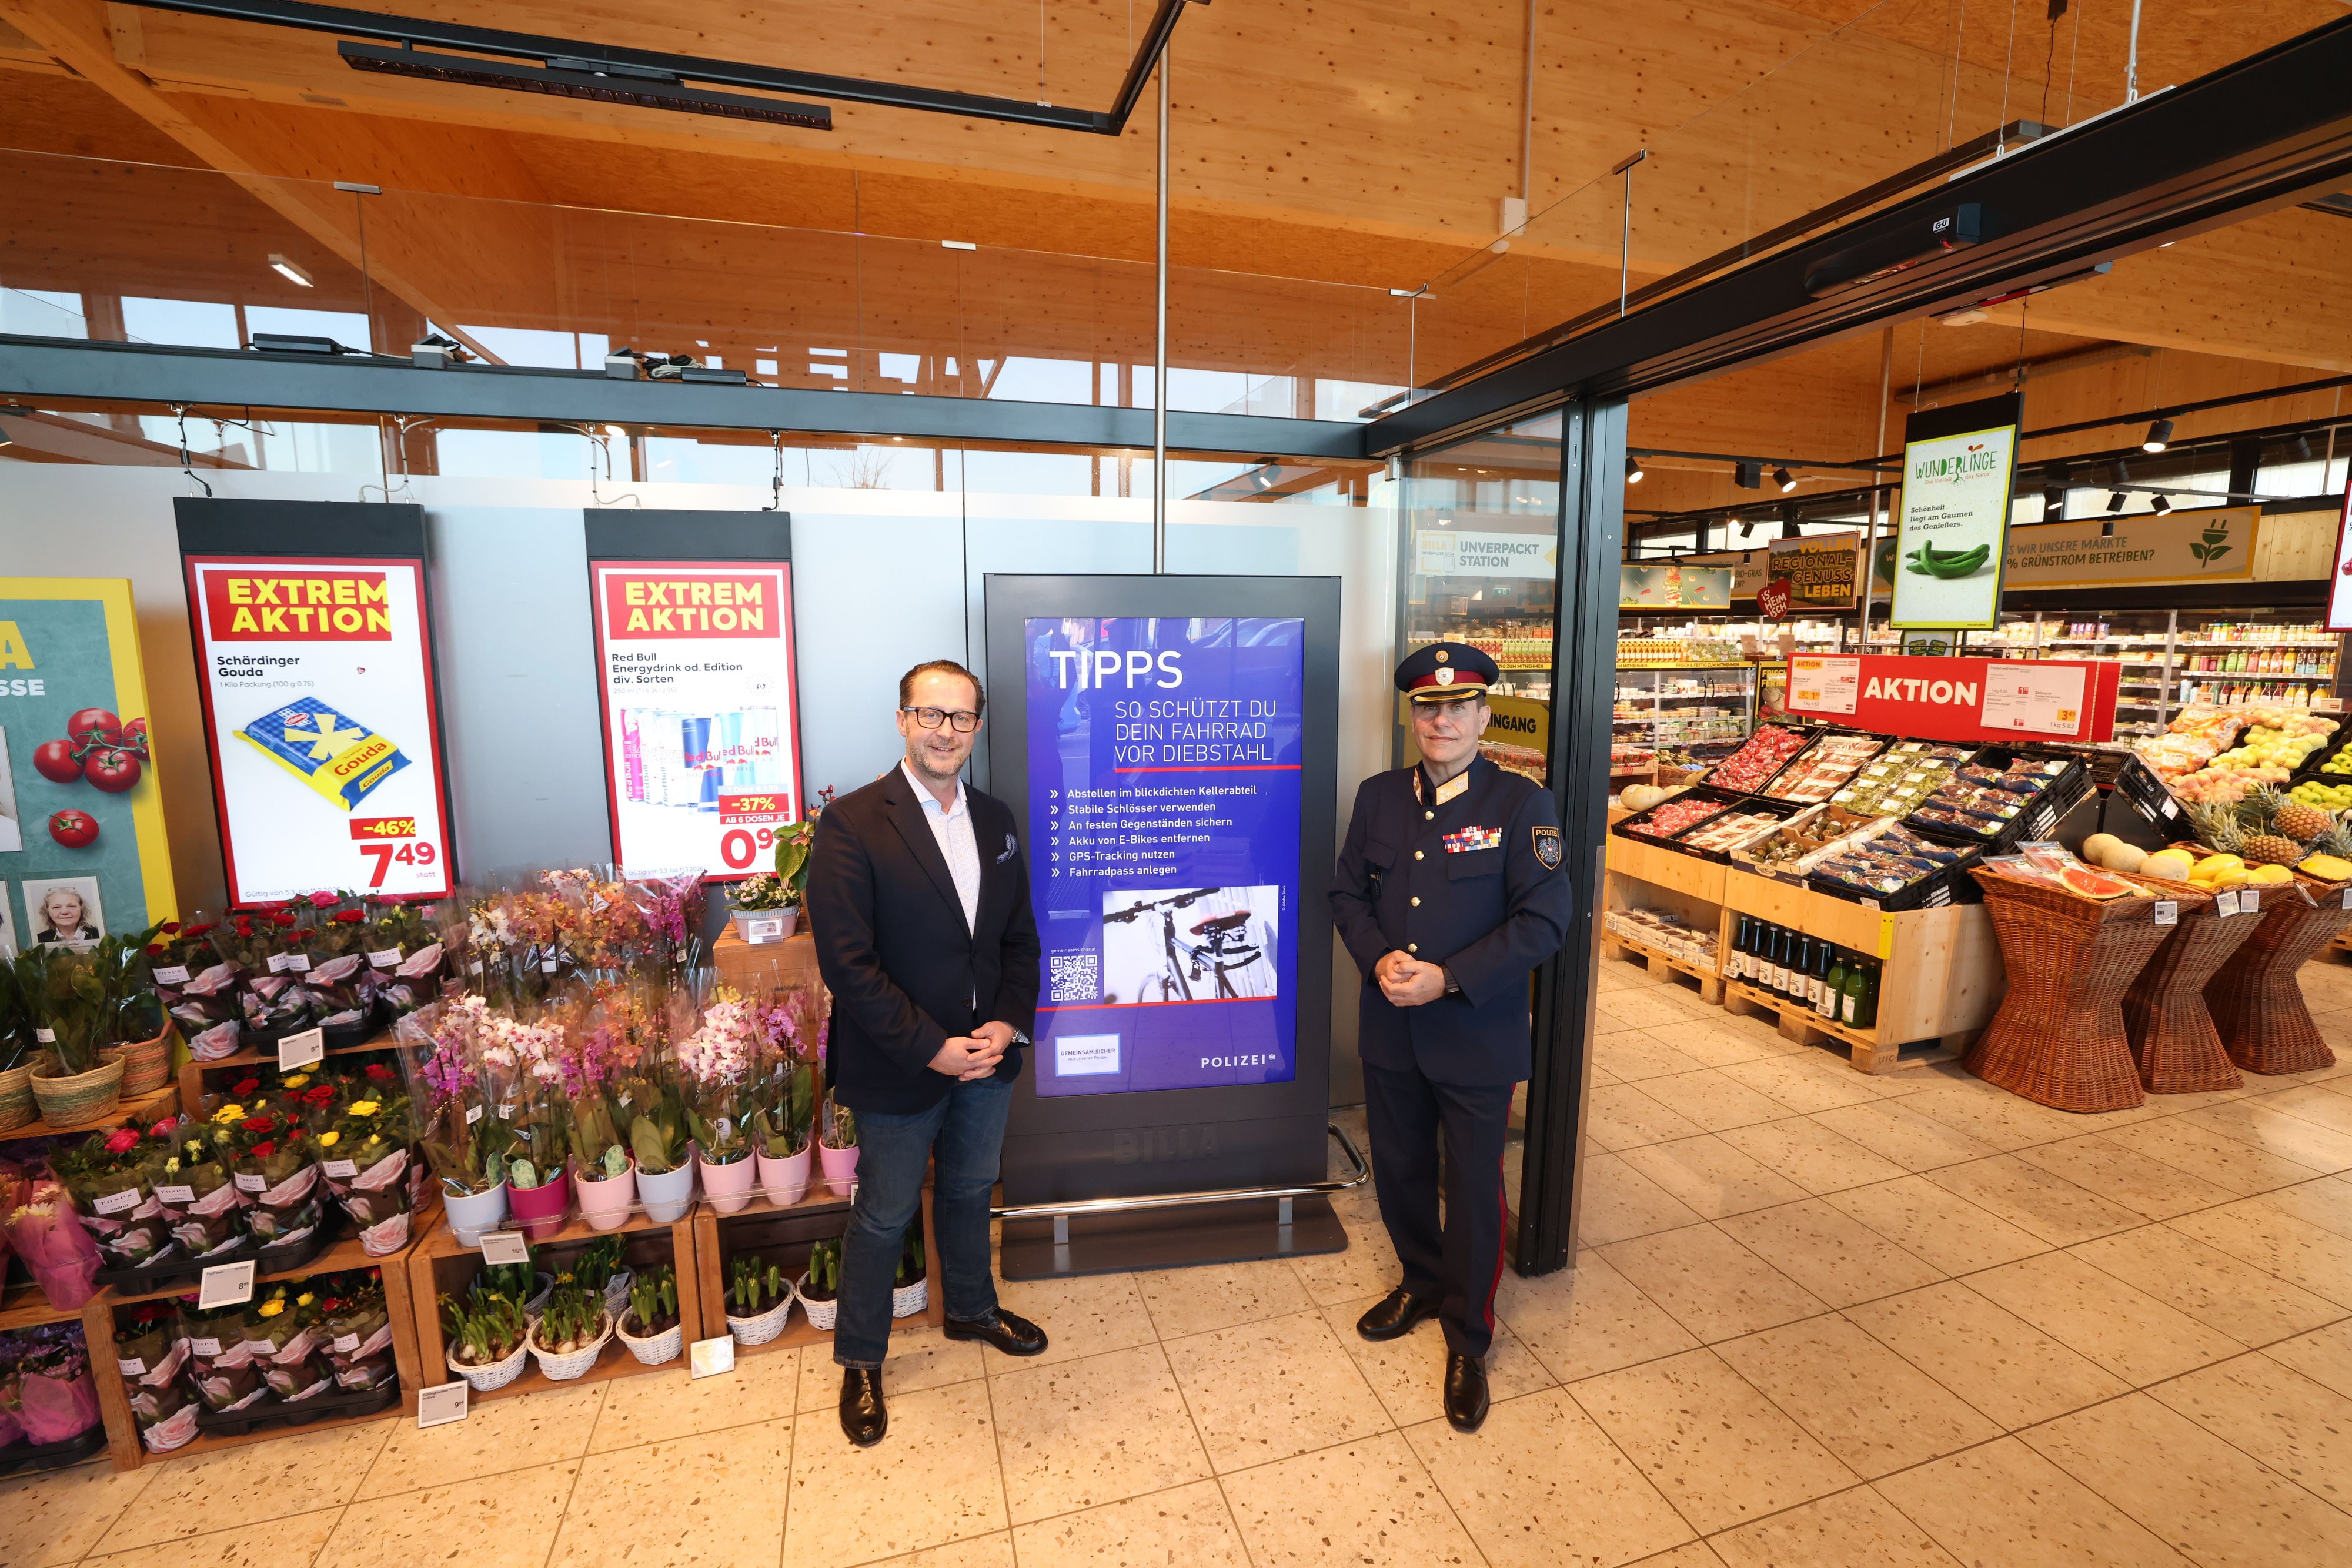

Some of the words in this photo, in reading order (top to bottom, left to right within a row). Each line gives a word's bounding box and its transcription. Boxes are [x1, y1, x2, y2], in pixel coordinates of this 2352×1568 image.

[1915, 451, 1997, 479] WUNDERLINGE
[1910, 504, 1945, 513] Schönheit
[1941, 511, 1973, 520] Gaumen
[1923, 521, 1963, 530] Genießers.
[1421, 540, 1447, 551] BILLA
[1459, 541, 1540, 556] UNVERPACKT
[1799, 538, 1854, 554] VOLLER
[2017, 544, 2037, 554] WIR
[2039, 540, 2079, 553] UNSERE
[2081, 536, 2129, 550] MÄRKTE
[1459, 555, 1509, 567] STATION
[1772, 553, 1853, 571] REGIONAL-
[2021, 554, 2086, 569] GRÜNSTROM
[2088, 549, 2155, 564] BETREIBEN?
[1735, 569, 1762, 578] BIO-GRAS
[1792, 569, 1852, 584] GENUSS
[227, 578, 389, 605] EXTREM
[624, 581, 763, 606] EXTREM
[1804, 584, 1851, 598] LEBEN
[231, 607, 392, 633] AKTION
[626, 607, 764, 631] AKTION
[217, 656, 300, 667] Schärdinger
[612, 653, 633, 661] Red
[636, 653, 657, 661] Bull
[218, 668, 263, 677] Gouda
[613, 664, 681, 674] Energydrink
[684, 663, 701, 672] od.
[704, 663, 743, 671] Edition
[1049, 650, 1184, 690] TIPPS
[613, 675, 633, 684] div.
[636, 674, 674, 683] Sorten
[1863, 677, 1978, 707] AKTION
[1115, 701, 1142, 719] SO
[1149, 697, 1242, 718] SCHÜTZT
[1250, 699, 1277, 718] DU
[1487, 713, 1536, 734] INGANG
[1116, 723, 1163, 741] DEIN
[1171, 721, 1267, 740] FAHRRAD
[761, 737, 779, 747] Bull
[707, 750, 723, 761] Bull
[723, 747, 736, 756] ed
[737, 745, 754, 756] Bull
[1114, 744, 1155, 763] VOR
[1162, 743, 1272, 762] DIEBSTAHL
[333, 742, 387, 776] Gouda
[363, 765, 390, 788] Gouda
[1067, 788, 1117, 799] Abstellen
[1119, 788, 1132, 797] im
[1135, 786, 1196, 797] blickdichten
[1198, 785, 1257, 795] Kellerabteil
[731, 796, 776, 811] -37%
[1068, 804, 1104, 814] Stabile
[1107, 803, 1158, 814] Schlösser
[1160, 802, 1216, 812] verwenden
[725, 815, 737, 824] AB
[745, 814, 773, 823] DOSEN
[774, 814, 786, 822] JE
[1068, 821, 1083, 830] An
[1085, 820, 1118, 830] festen
[1120, 819, 1192, 830] Gegenständen
[1195, 818, 1233, 827] sichern
[362, 820, 416, 835] -46%
[1068, 836, 1095, 846] Akku
[1098, 837, 1116, 845] von
[1119, 835, 1158, 844] E-Bikes
[1161, 834, 1211, 843] entfernen
[1068, 850, 1138, 862] GPS-Tracking
[1141, 851, 1175, 860] nutzen
[1069, 867, 1134, 878] Fahrradpass
[1137, 865, 1177, 877] anlegen
[1201, 1054, 1267, 1069] POLIZEI
[1113, 1127, 1221, 1165] BILLA
[101, 1192, 132, 1206] roses
[109, 1203, 129, 1212] nolina
